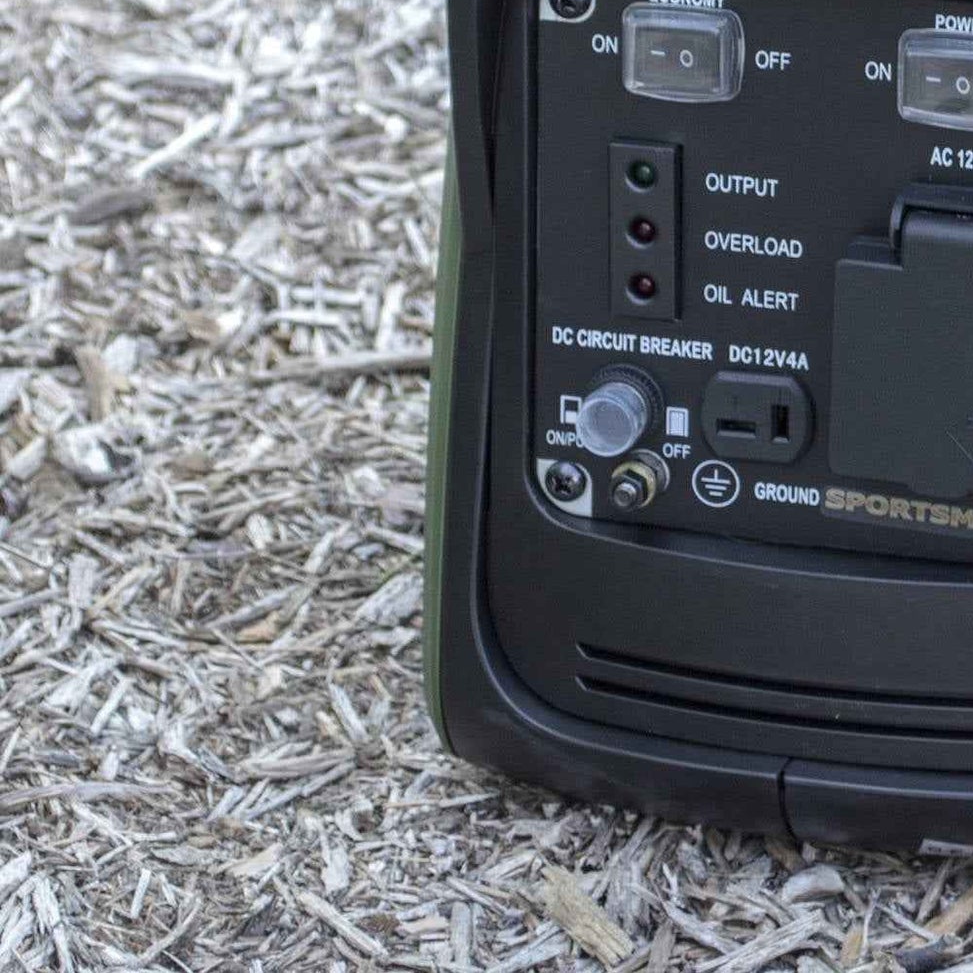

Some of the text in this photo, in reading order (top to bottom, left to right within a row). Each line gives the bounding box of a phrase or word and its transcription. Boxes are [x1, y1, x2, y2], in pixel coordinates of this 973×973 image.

[591, 33, 618, 54] ON
[755, 50, 791, 70] OFF
[864, 60, 892, 81] ON
[930, 146, 953, 167] AC
[705, 172, 778, 197] OUTPUT
[704, 230, 803, 258] OVERLOAD
[703, 283, 799, 311] OIL ALERT
[552, 326, 713, 360] DC CIRCUIT BREAKER
[728, 344, 809, 371] DC12V4A
[662, 442, 691, 459] OFF
[754, 481, 820, 506] GROUND
